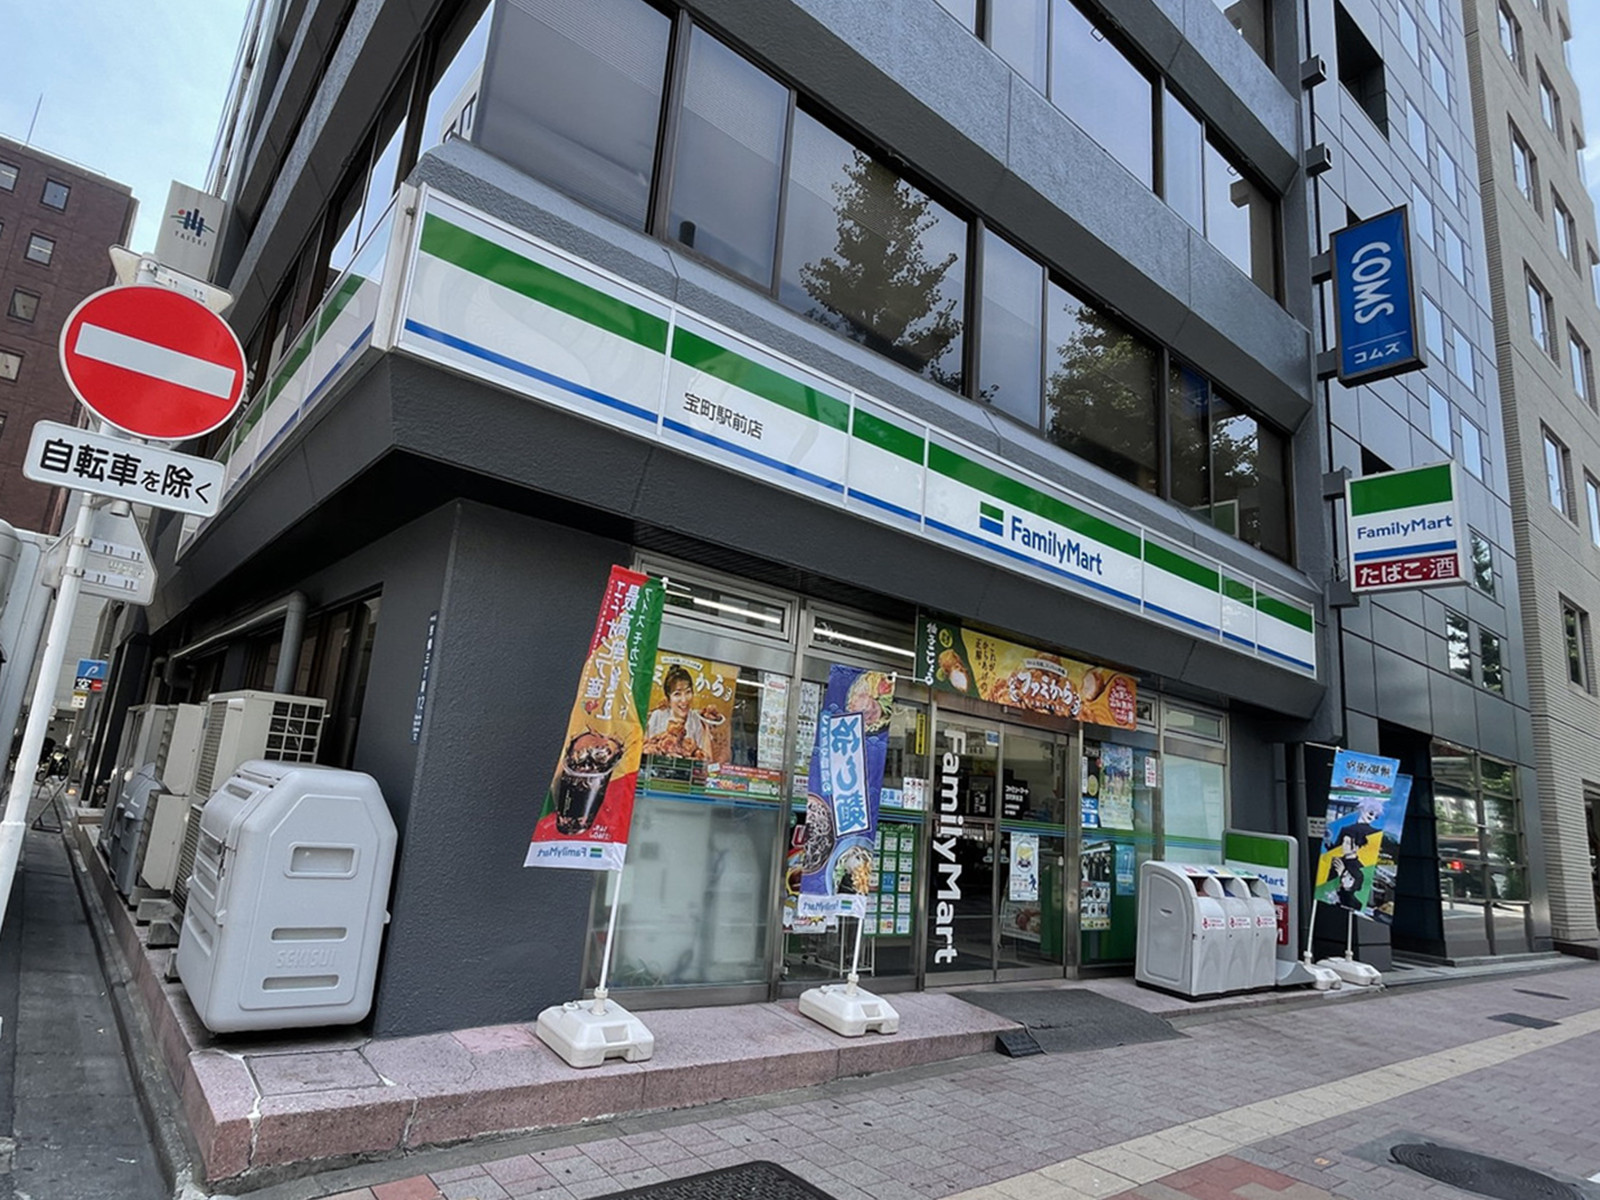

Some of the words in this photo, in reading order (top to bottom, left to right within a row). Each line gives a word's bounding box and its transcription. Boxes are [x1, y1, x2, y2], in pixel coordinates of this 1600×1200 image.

[174, 230, 207, 248] TAISEI
[1351, 240, 1395, 325] COMS
[1354, 342, 1401, 365] コムス
[683, 391, 764, 441] 宝町駅前店
[39, 437, 213, 505] 自転車を除く
[1010, 516, 1103, 577] FamilyMart
[1356, 512, 1453, 541] FamilyMart
[932, 729, 966, 964] FamilyMart
